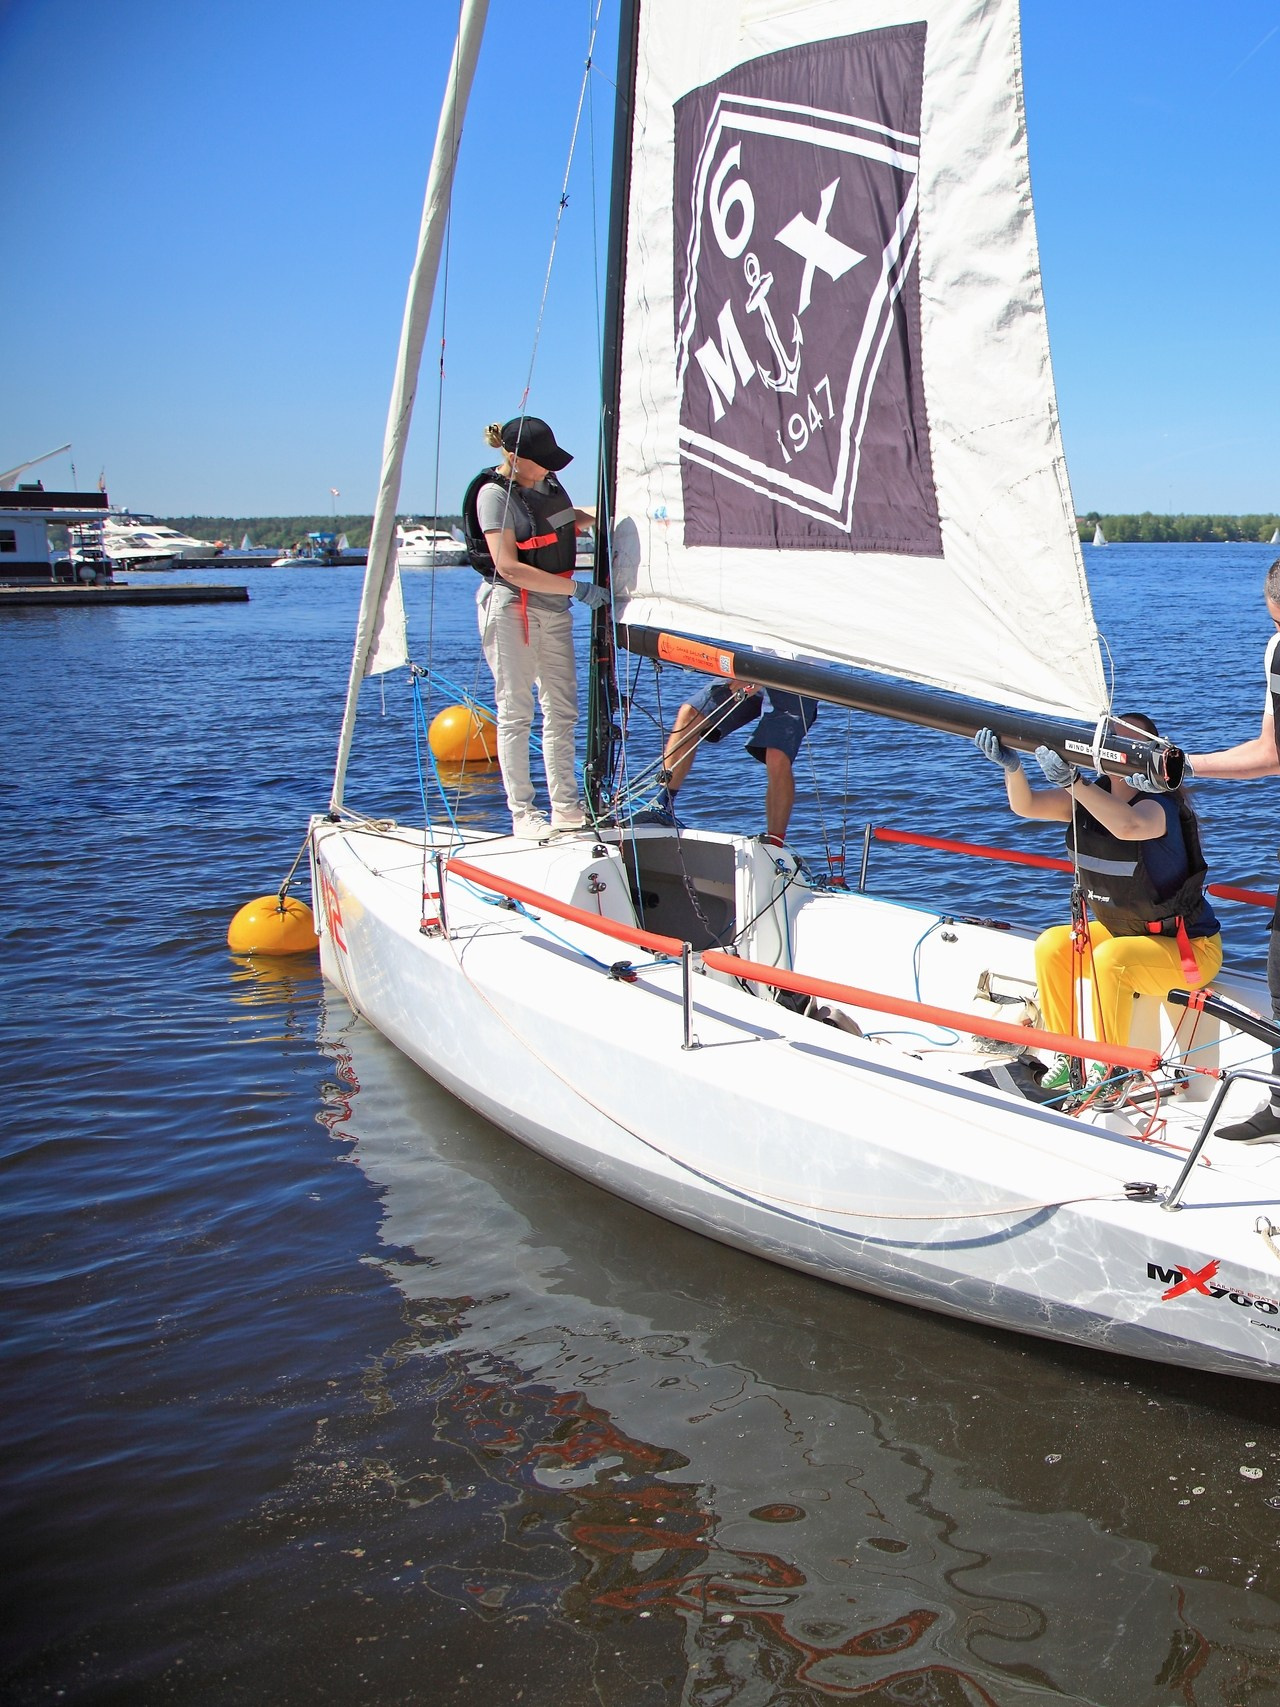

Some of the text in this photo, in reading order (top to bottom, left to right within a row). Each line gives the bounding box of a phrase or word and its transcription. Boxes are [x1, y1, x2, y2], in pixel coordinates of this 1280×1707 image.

[774, 176, 868, 316] X
[695, 300, 755, 422] M
[776, 374, 836, 464] 1947
[1068, 742, 1118, 760] WIND BHERS
[1147, 1259, 1222, 1301] MX
[1208, 1285, 1279, 1315] 700
[1210, 1281, 1279, 1306] SAILING BOATS
